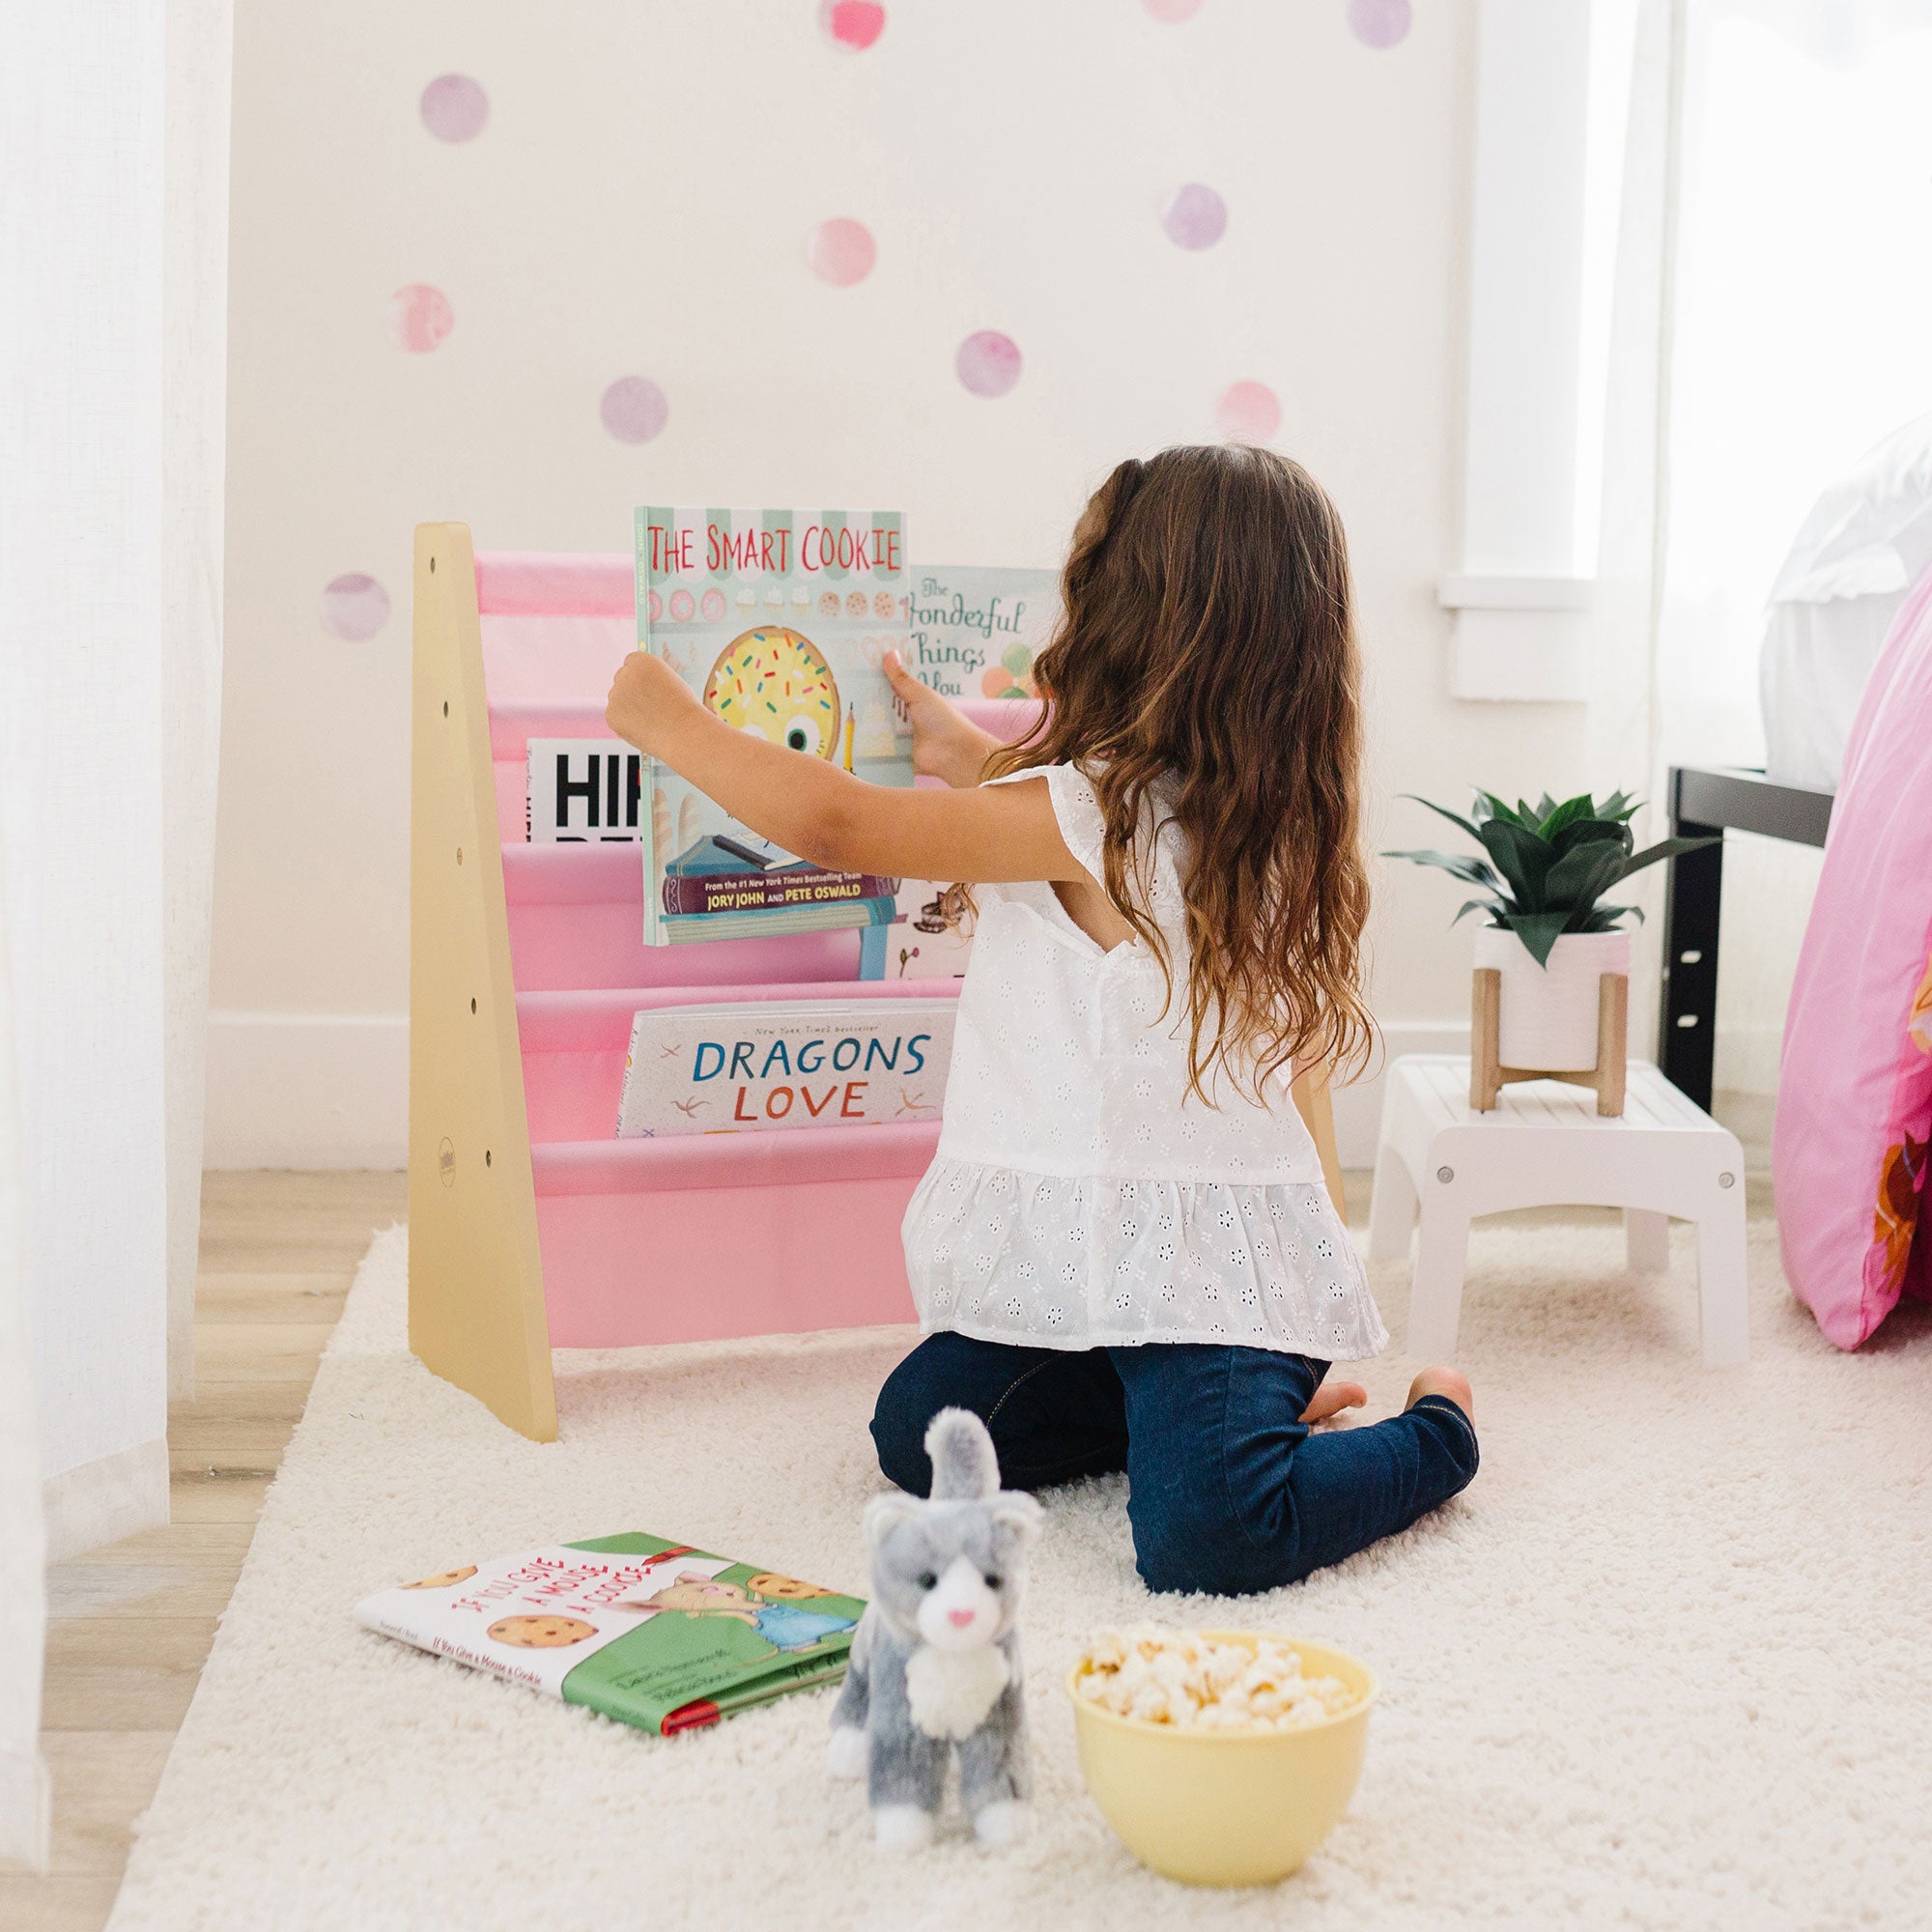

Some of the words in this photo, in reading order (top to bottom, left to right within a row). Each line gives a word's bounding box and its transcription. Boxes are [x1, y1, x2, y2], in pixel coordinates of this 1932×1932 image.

[647, 526, 695, 573] THE
[706, 524, 791, 572] SMART
[802, 526, 900, 572] COOKIE
[921, 578, 949, 597] The
[911, 632, 985, 674] hings
[705, 883, 724, 892] From
[724, 881, 737, 890] the
[738, 880, 748, 889] #1
[749, 879, 764, 888] New
[766, 877, 782, 887] York
[783, 875, 804, 885] Times
[804, 872, 842, 883] Bestselling
[707, 895, 734, 912] JORY
[736, 892, 765, 909] JOHN
[767, 893, 784, 903] AND
[785, 888, 812, 901] PETE
[814, 883, 862, 899] OSWALD
[693, 1034, 931, 1082] DRAGONS
[734, 1081, 869, 1122] LOVE
[450, 1597, 490, 1613] IF
[508, 1556, 564, 1583] GIVE
[534, 1563, 609, 1597] MOUSE
[566, 1604, 595, 1614] A
[582, 1566, 652, 1603] COOKIE
[522, 1596, 552, 1606] A
[433, 1636, 441, 1648] If
[441, 1640, 454, 1655] You
[456, 1645, 472, 1662] Give
[482, 1655, 506, 1672] Mouse
[514, 1667, 541, 1685] Cookie
